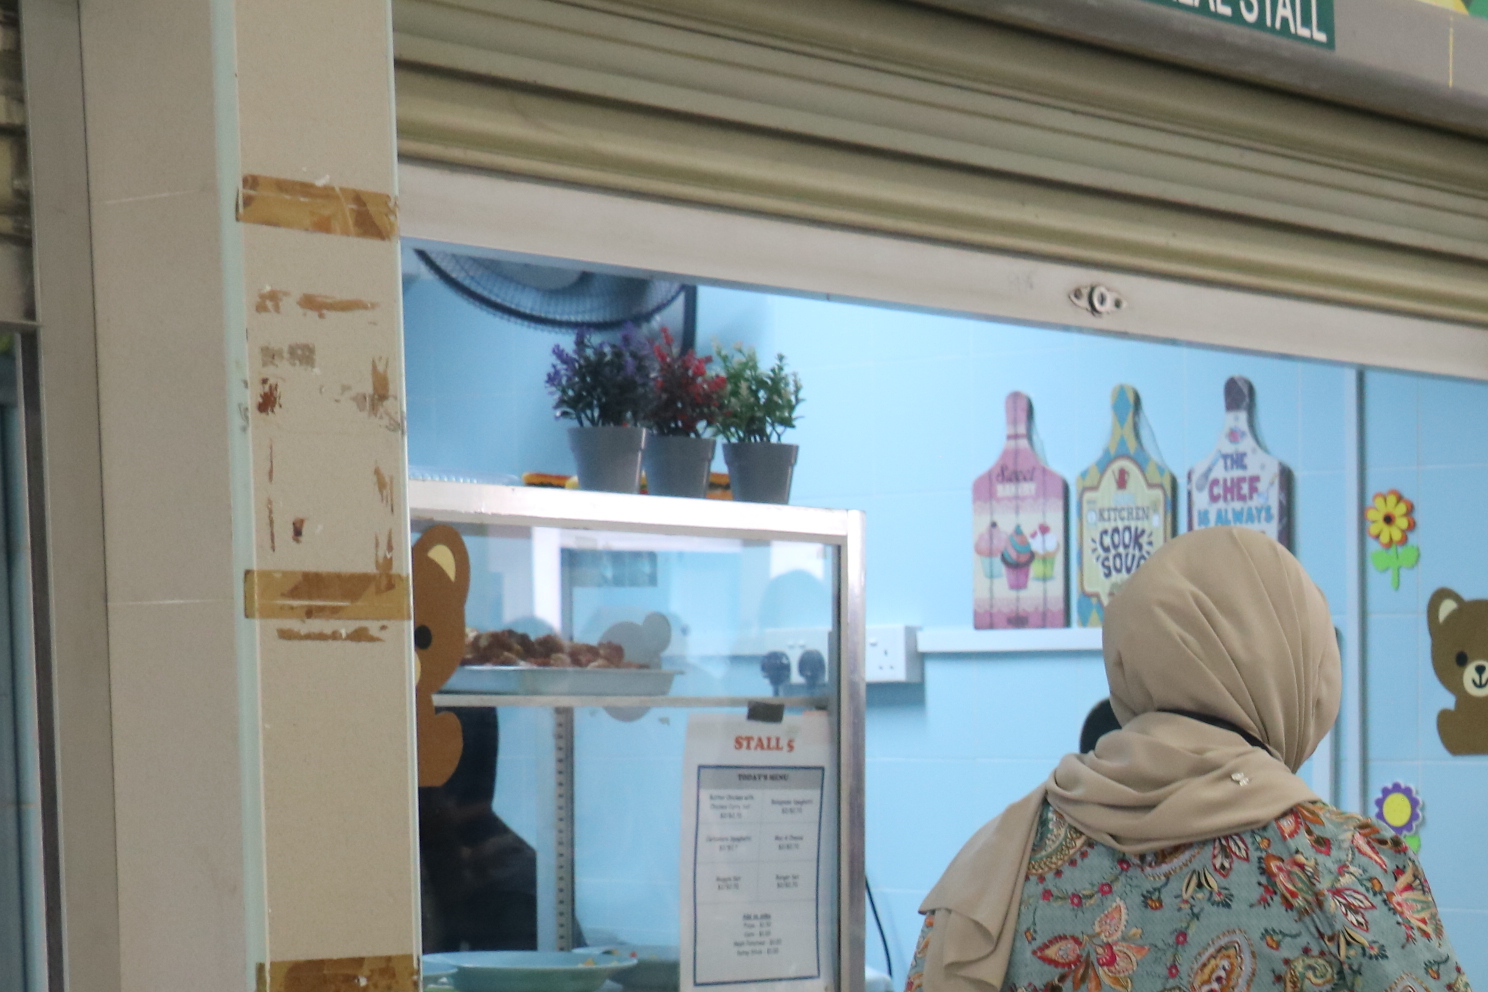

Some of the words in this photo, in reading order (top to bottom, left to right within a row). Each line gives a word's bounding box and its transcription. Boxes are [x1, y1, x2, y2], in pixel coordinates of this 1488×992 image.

[1221, 452, 1248, 472] THE
[1208, 476, 1261, 503] CHEF
[1098, 506, 1149, 522] KITCHEN
[1197, 509, 1211, 527] IS
[1214, 505, 1274, 526] ALWAYS
[1099, 526, 1146, 553] COOK
[734, 735, 784, 751] STALL
[786, 738, 796, 753] 5
